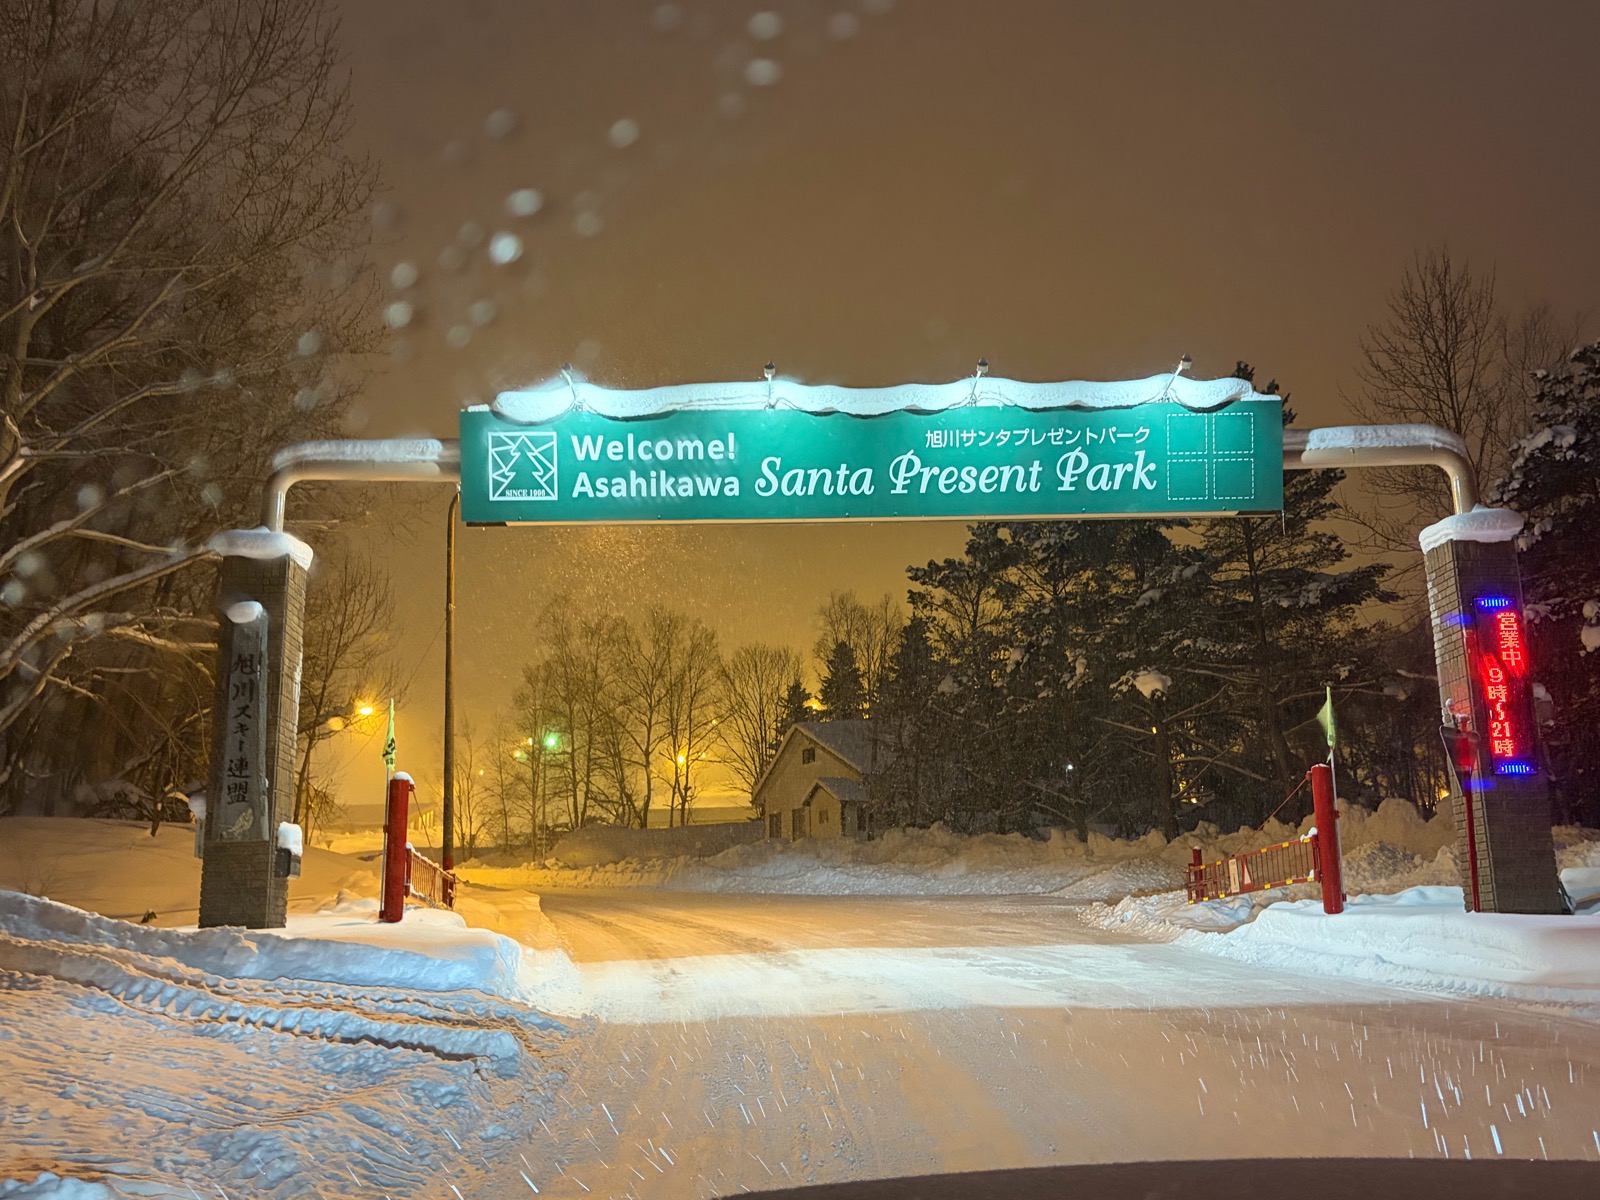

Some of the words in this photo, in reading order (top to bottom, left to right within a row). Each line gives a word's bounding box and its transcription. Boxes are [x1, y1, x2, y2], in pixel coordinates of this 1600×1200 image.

[571, 432, 736, 461] Welcome!
[925, 426, 1151, 448] 旭川サンタプレゼントパーク
[571, 470, 740, 498] Asahikawa
[754, 456, 875, 498] Santa
[889, 448, 1043, 495] Present
[1057, 445, 1158, 492] Park
[505, 489, 528, 497] SINCE
[1497, 612, 1521, 667] 営業中
[226, 652, 257, 805] 旭川スキー連盟
